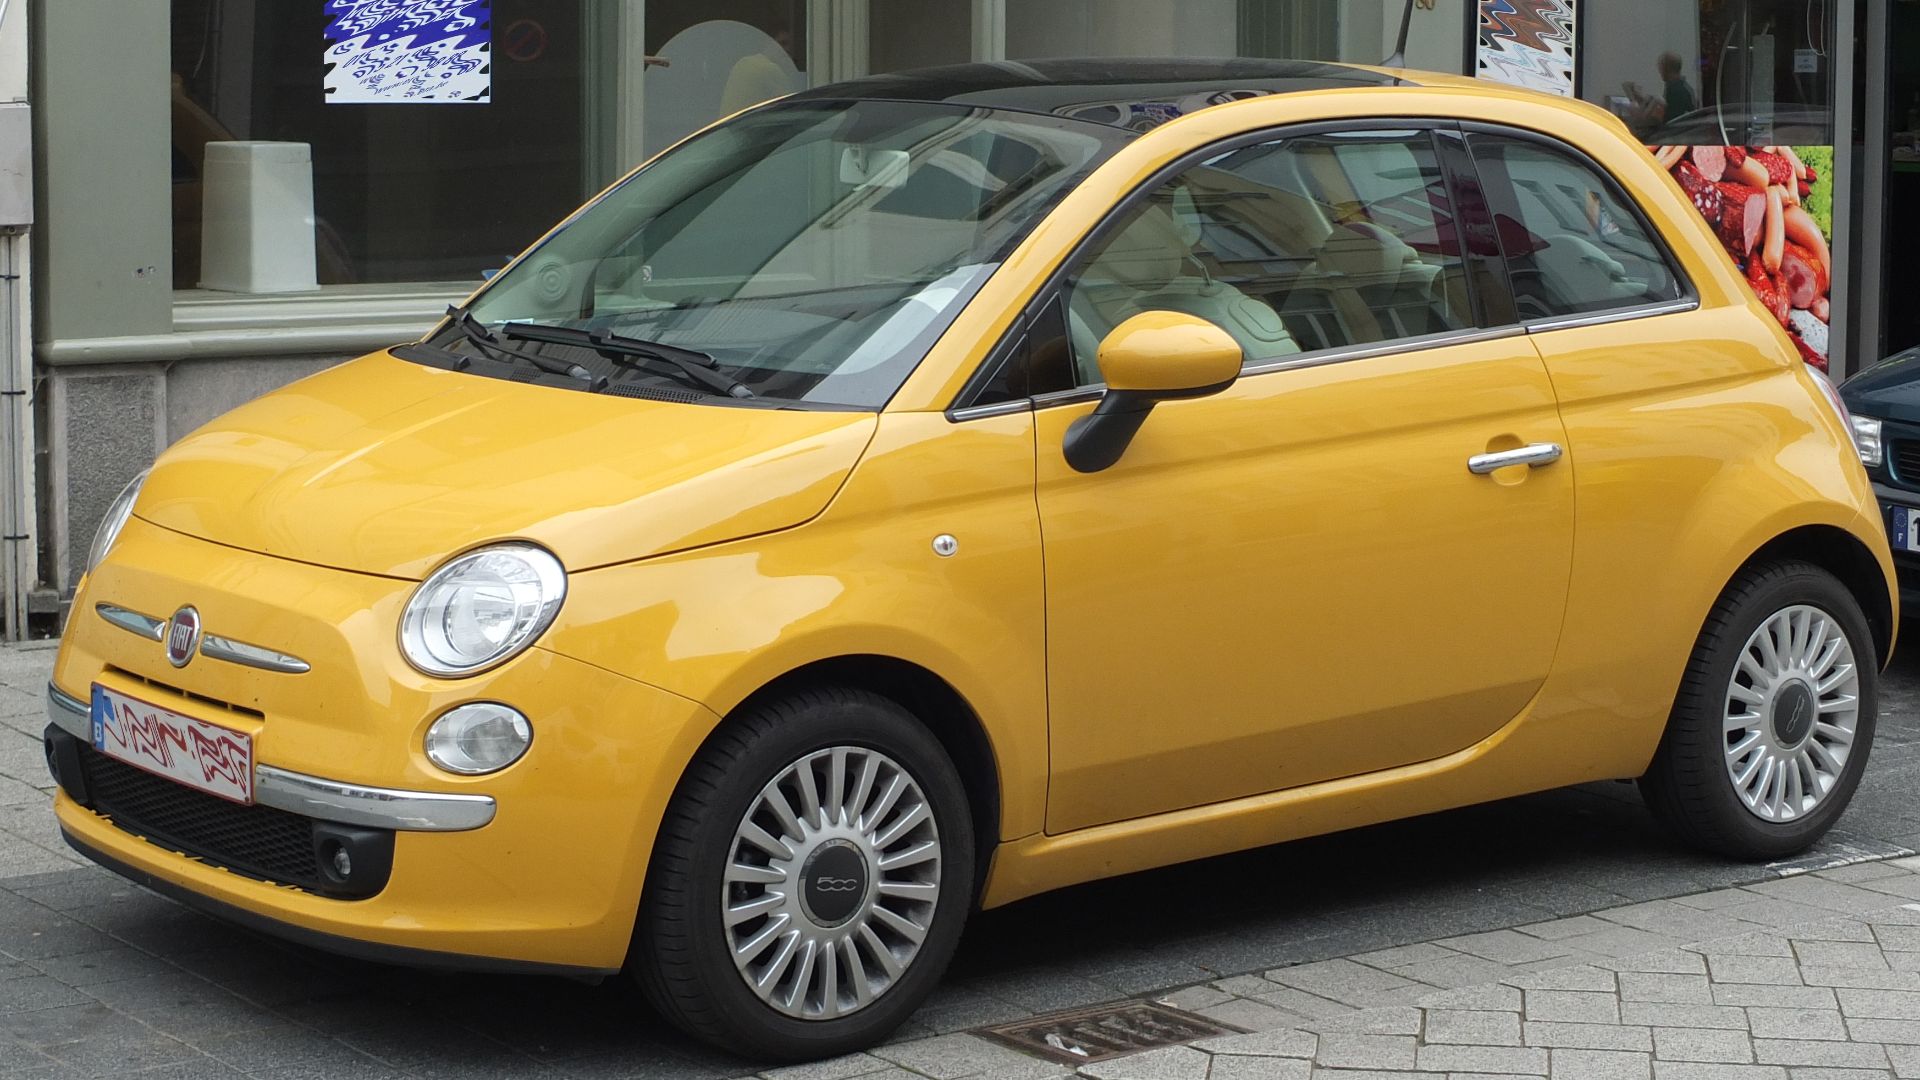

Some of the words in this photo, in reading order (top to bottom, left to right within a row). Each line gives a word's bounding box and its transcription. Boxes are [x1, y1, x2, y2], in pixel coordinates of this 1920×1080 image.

[1898, 532, 1904, 543] F
[172, 623, 193, 651] FIAT
[816, 876, 858, 892] 500
